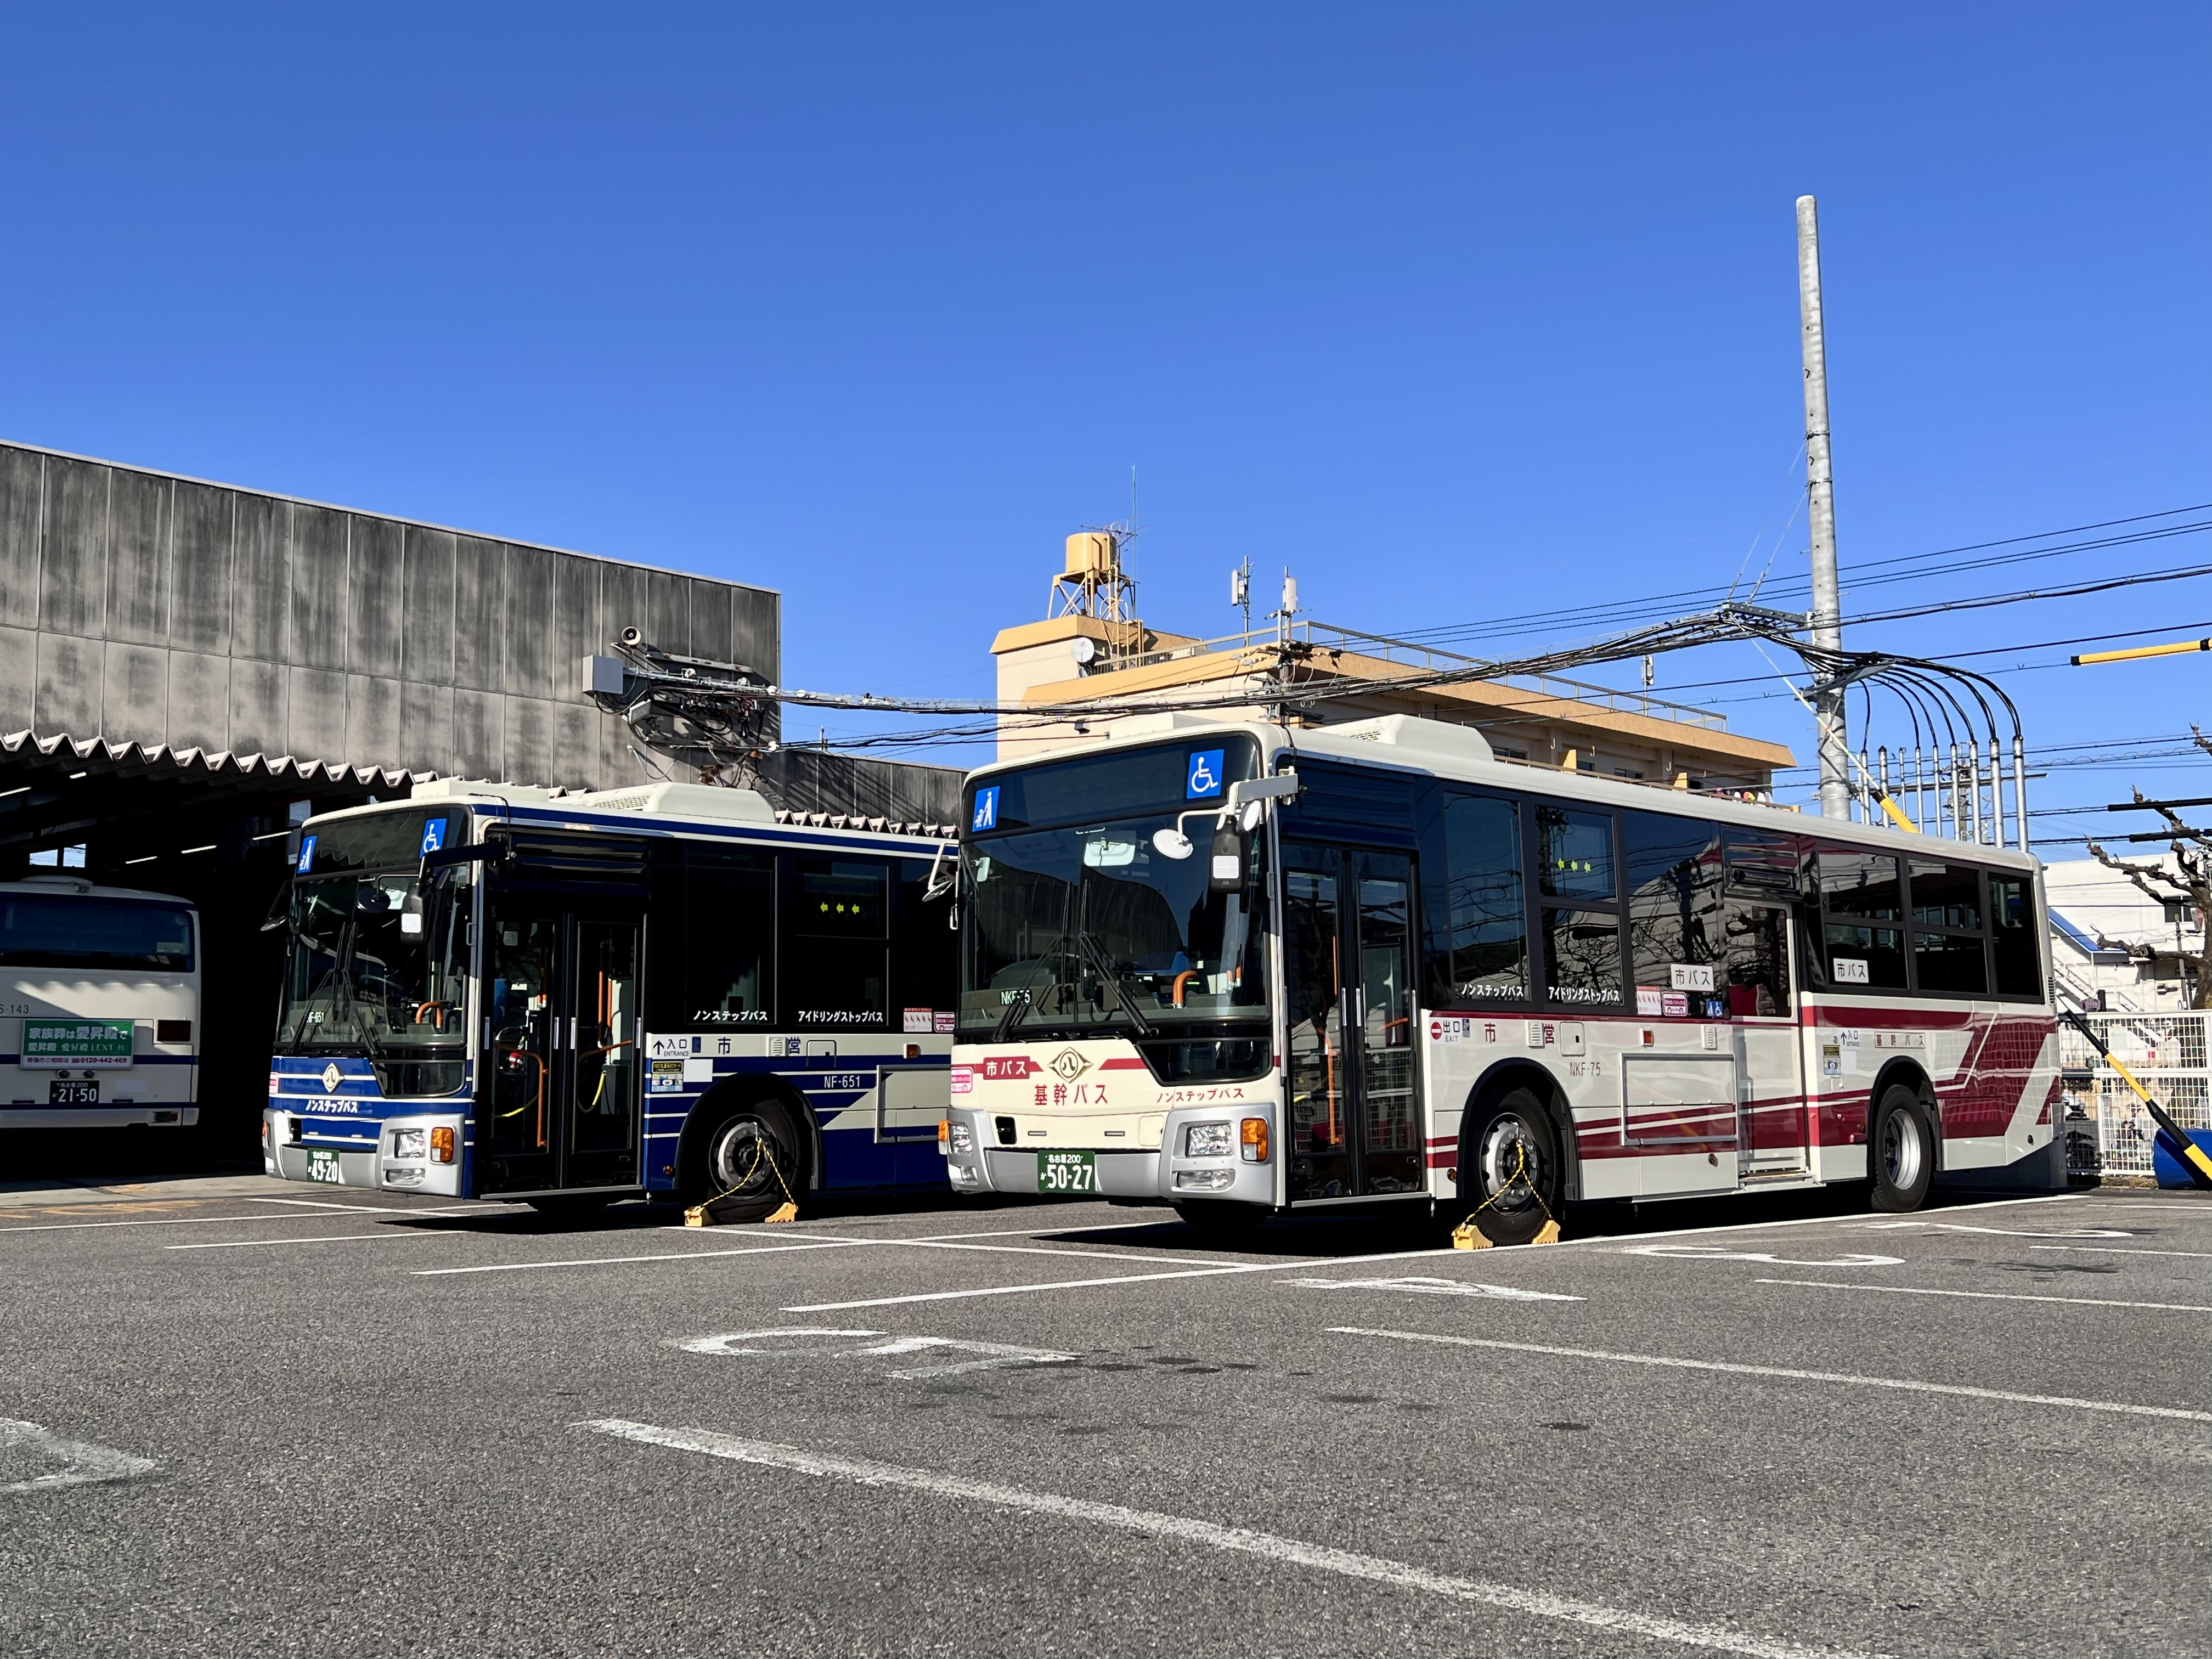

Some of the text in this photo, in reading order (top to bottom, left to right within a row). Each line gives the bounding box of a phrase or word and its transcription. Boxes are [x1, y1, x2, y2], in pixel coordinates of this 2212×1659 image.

[1675, 969, 1710, 985] 市バス
[1837, 962, 1866, 978] 市バス
[1001, 989, 1030, 1005] NKF-5
[1462, 984, 1524, 997] ノンステップバス
[1548, 986, 1620, 1002] アイドリングストップバス
[693, 1010, 768, 1021] ノンステップバス
[798, 1011, 884, 1023] アイドリングストップバス
[1443, 1020, 1460, 1033] 出口
[1485, 1022, 1555, 1045] 市 営
[1847, 1030, 1859, 1040] 入口
[1876, 1034, 1925, 1047] 基幹バス
[667, 1039, 687, 1049] 入口
[718, 1036, 801, 1055] 市 営
[986, 1060, 1028, 1077] 市バス
[1570, 1062, 1601, 1076] NKF-75
[824, 1075, 860, 1089] NF-651
[58, 1088, 97, 1103] 21-50
[1034, 1083, 1108, 1106] 基幹バス
[1156, 1087, 1244, 1103] ノンステップバス
[305, 1099, 358, 1114] ノンステップバス
[311, 1159, 338, 1182] 49-20
[1047, 1164, 1093, 1190] 50-27
